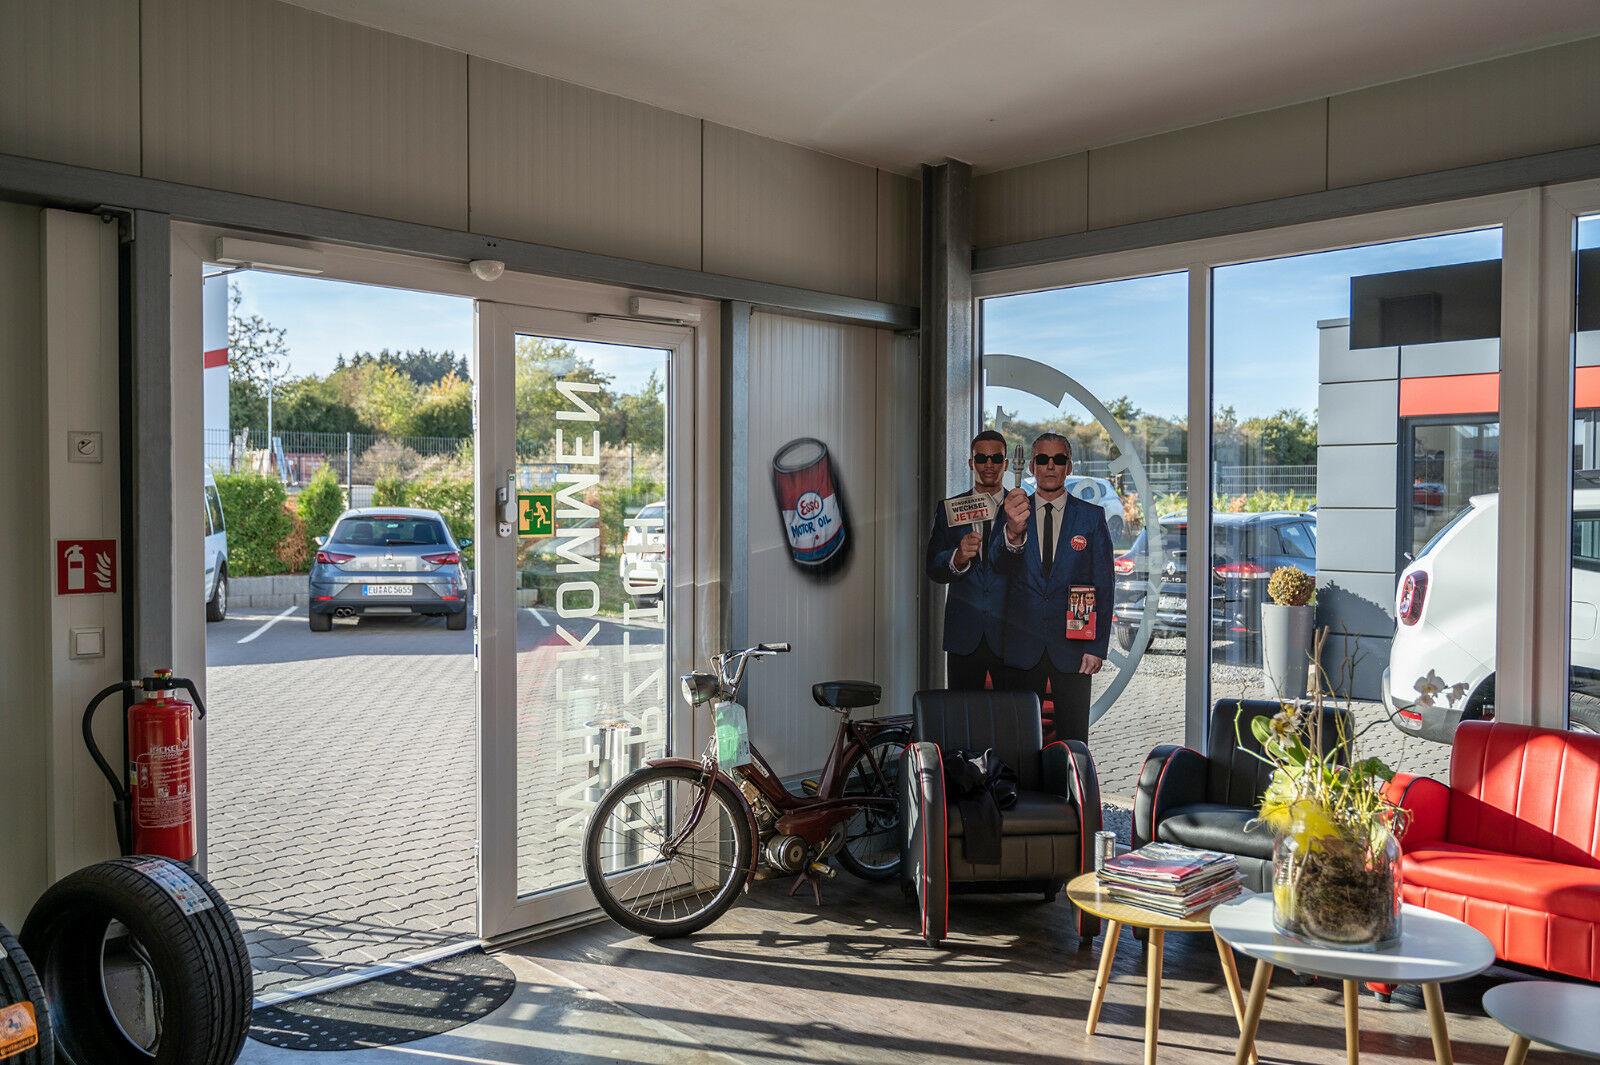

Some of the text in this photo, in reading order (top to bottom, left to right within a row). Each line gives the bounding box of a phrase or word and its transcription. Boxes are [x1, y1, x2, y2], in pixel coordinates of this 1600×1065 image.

[952, 502, 987, 513] WECHSEL
[954, 508, 989, 522] JETZT!
[791, 515, 831, 538] MOTOR OIL
